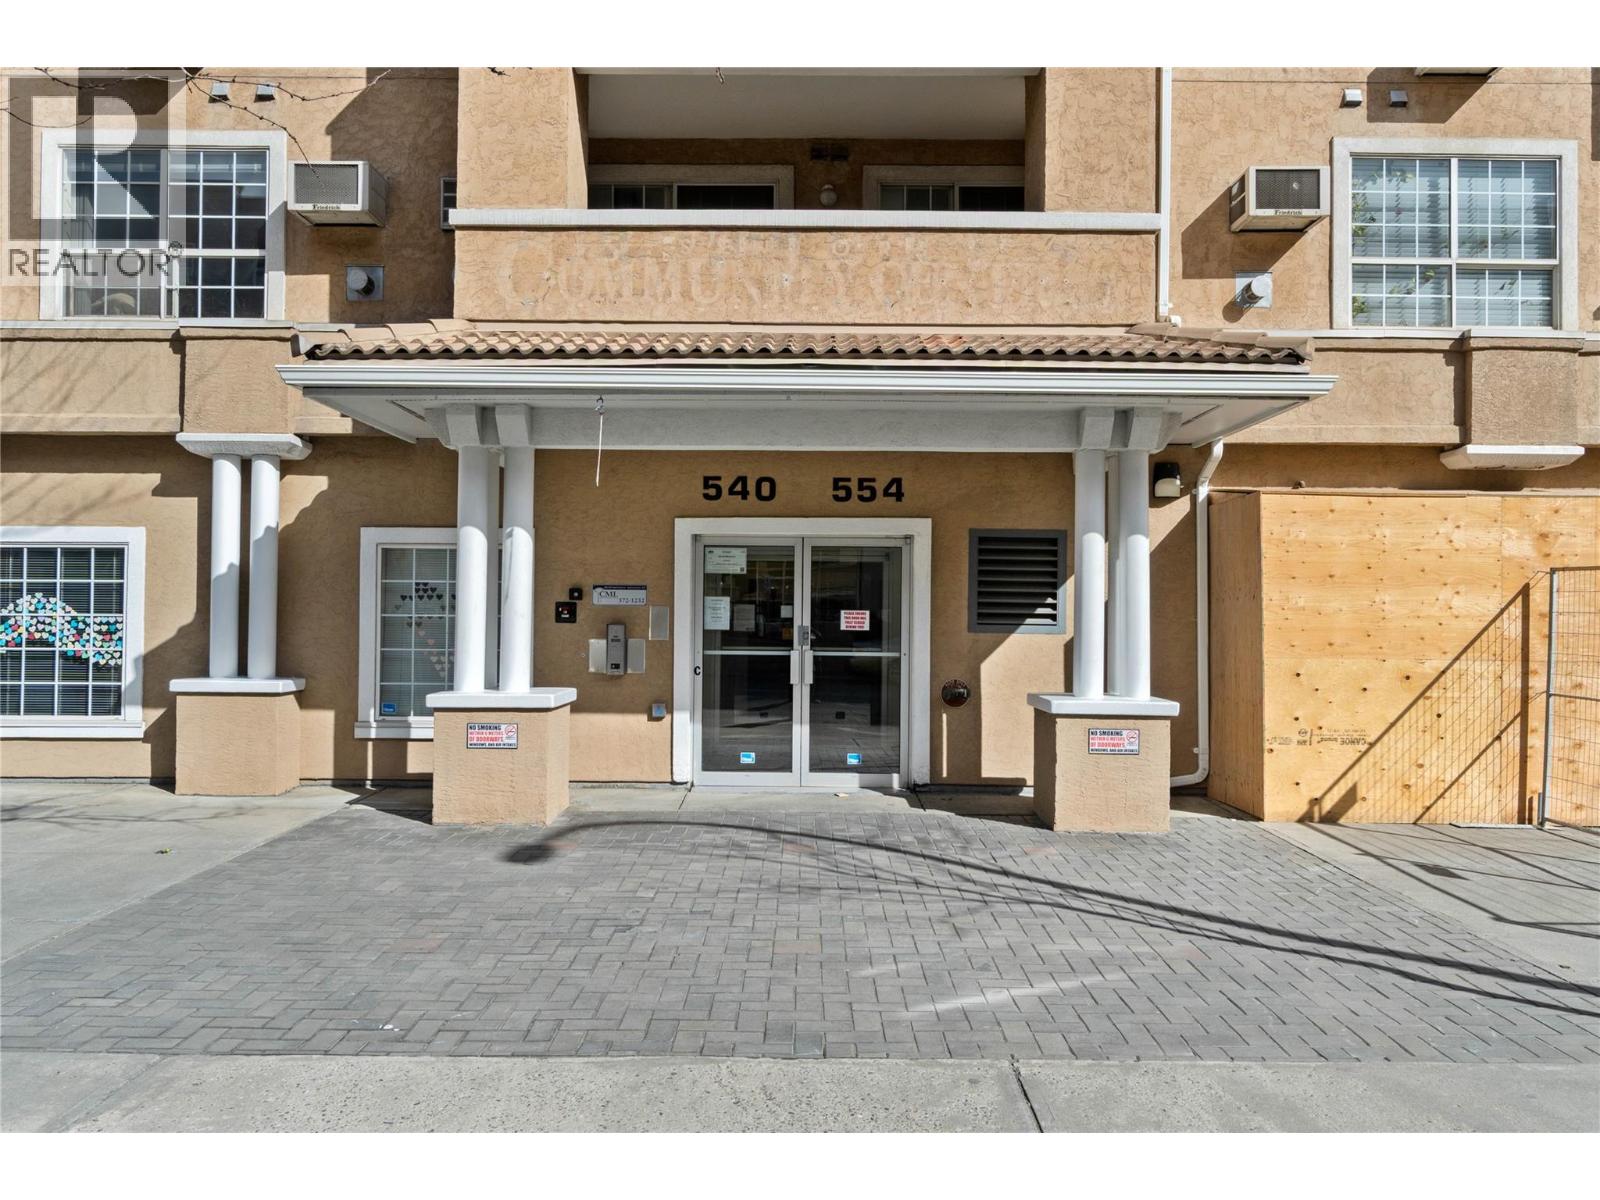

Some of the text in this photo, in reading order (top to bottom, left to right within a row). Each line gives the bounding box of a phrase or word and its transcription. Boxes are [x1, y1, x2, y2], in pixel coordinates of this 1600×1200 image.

[702, 475, 905, 502] 540 554
[694, 665, 701, 676] C
